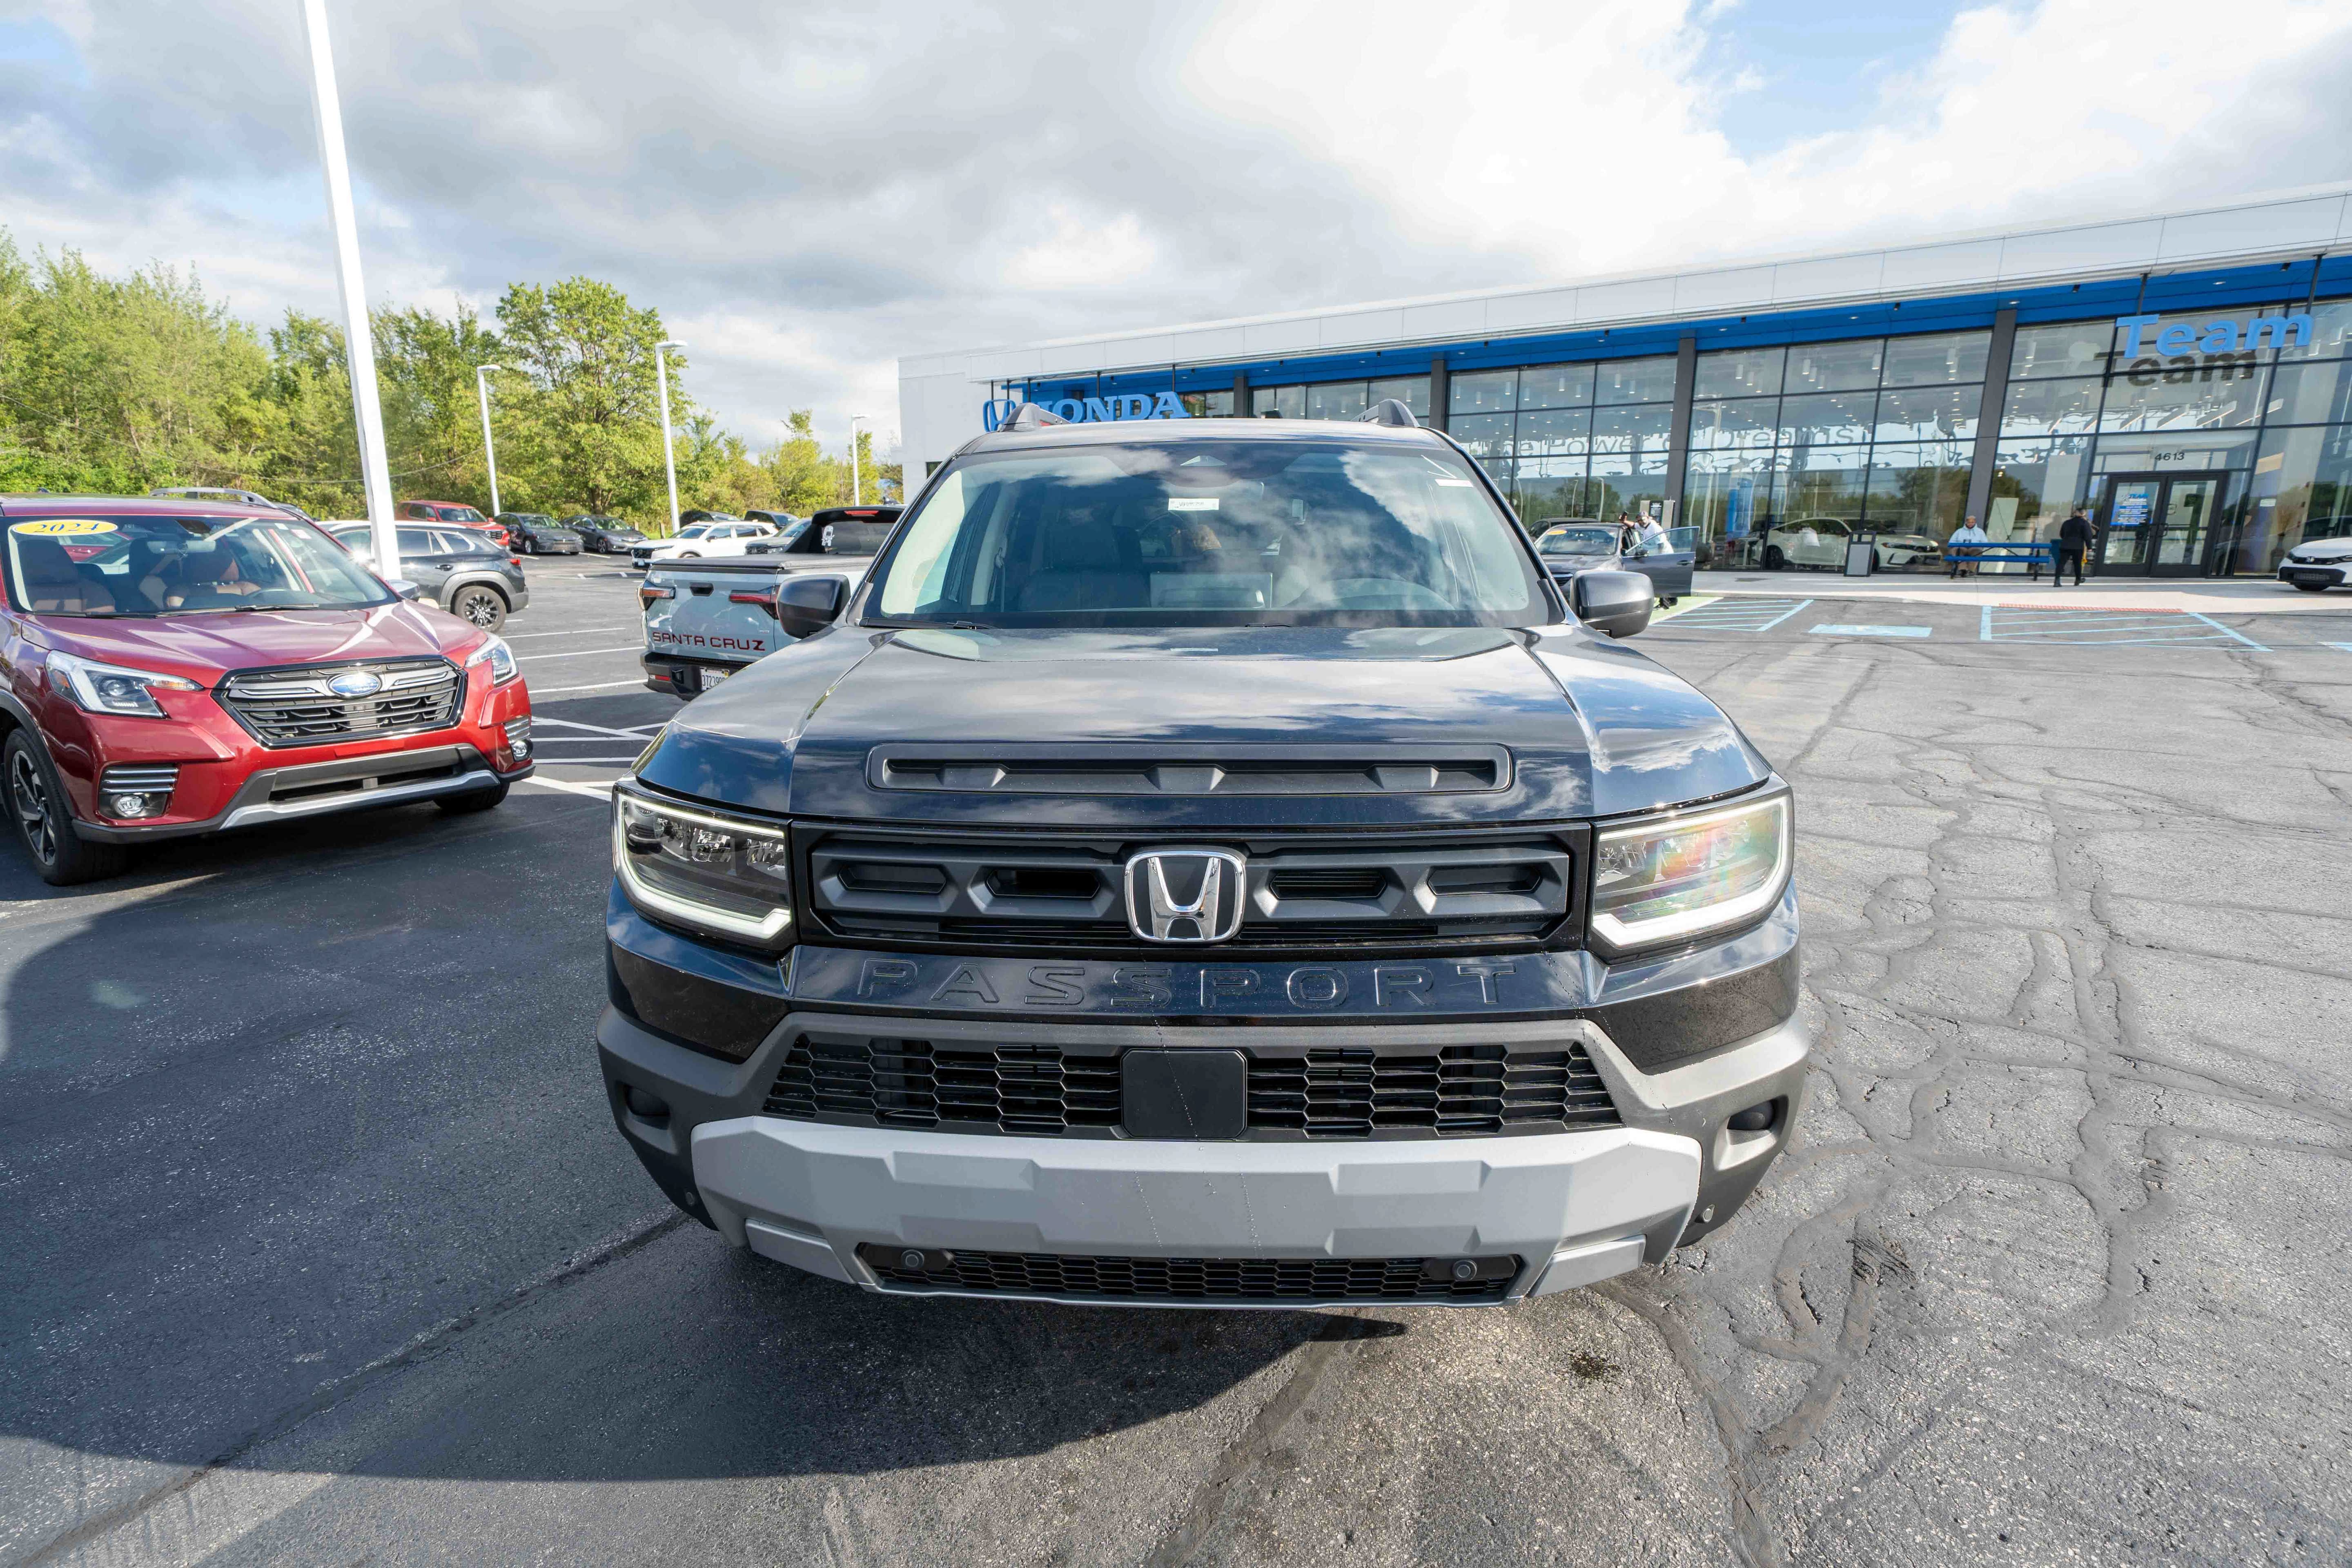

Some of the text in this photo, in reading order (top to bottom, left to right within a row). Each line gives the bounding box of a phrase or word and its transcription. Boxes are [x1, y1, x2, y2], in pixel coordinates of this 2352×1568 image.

[2115, 314, 2314, 359] Team
[1036, 391, 1192, 424] ONDA
[2155, 452, 2185, 461] 4613
[33, 523, 99, 532] 2024
[653, 632, 765, 651] SANTA CRUZ
[857, 958, 1517, 1007] PASSPORT
